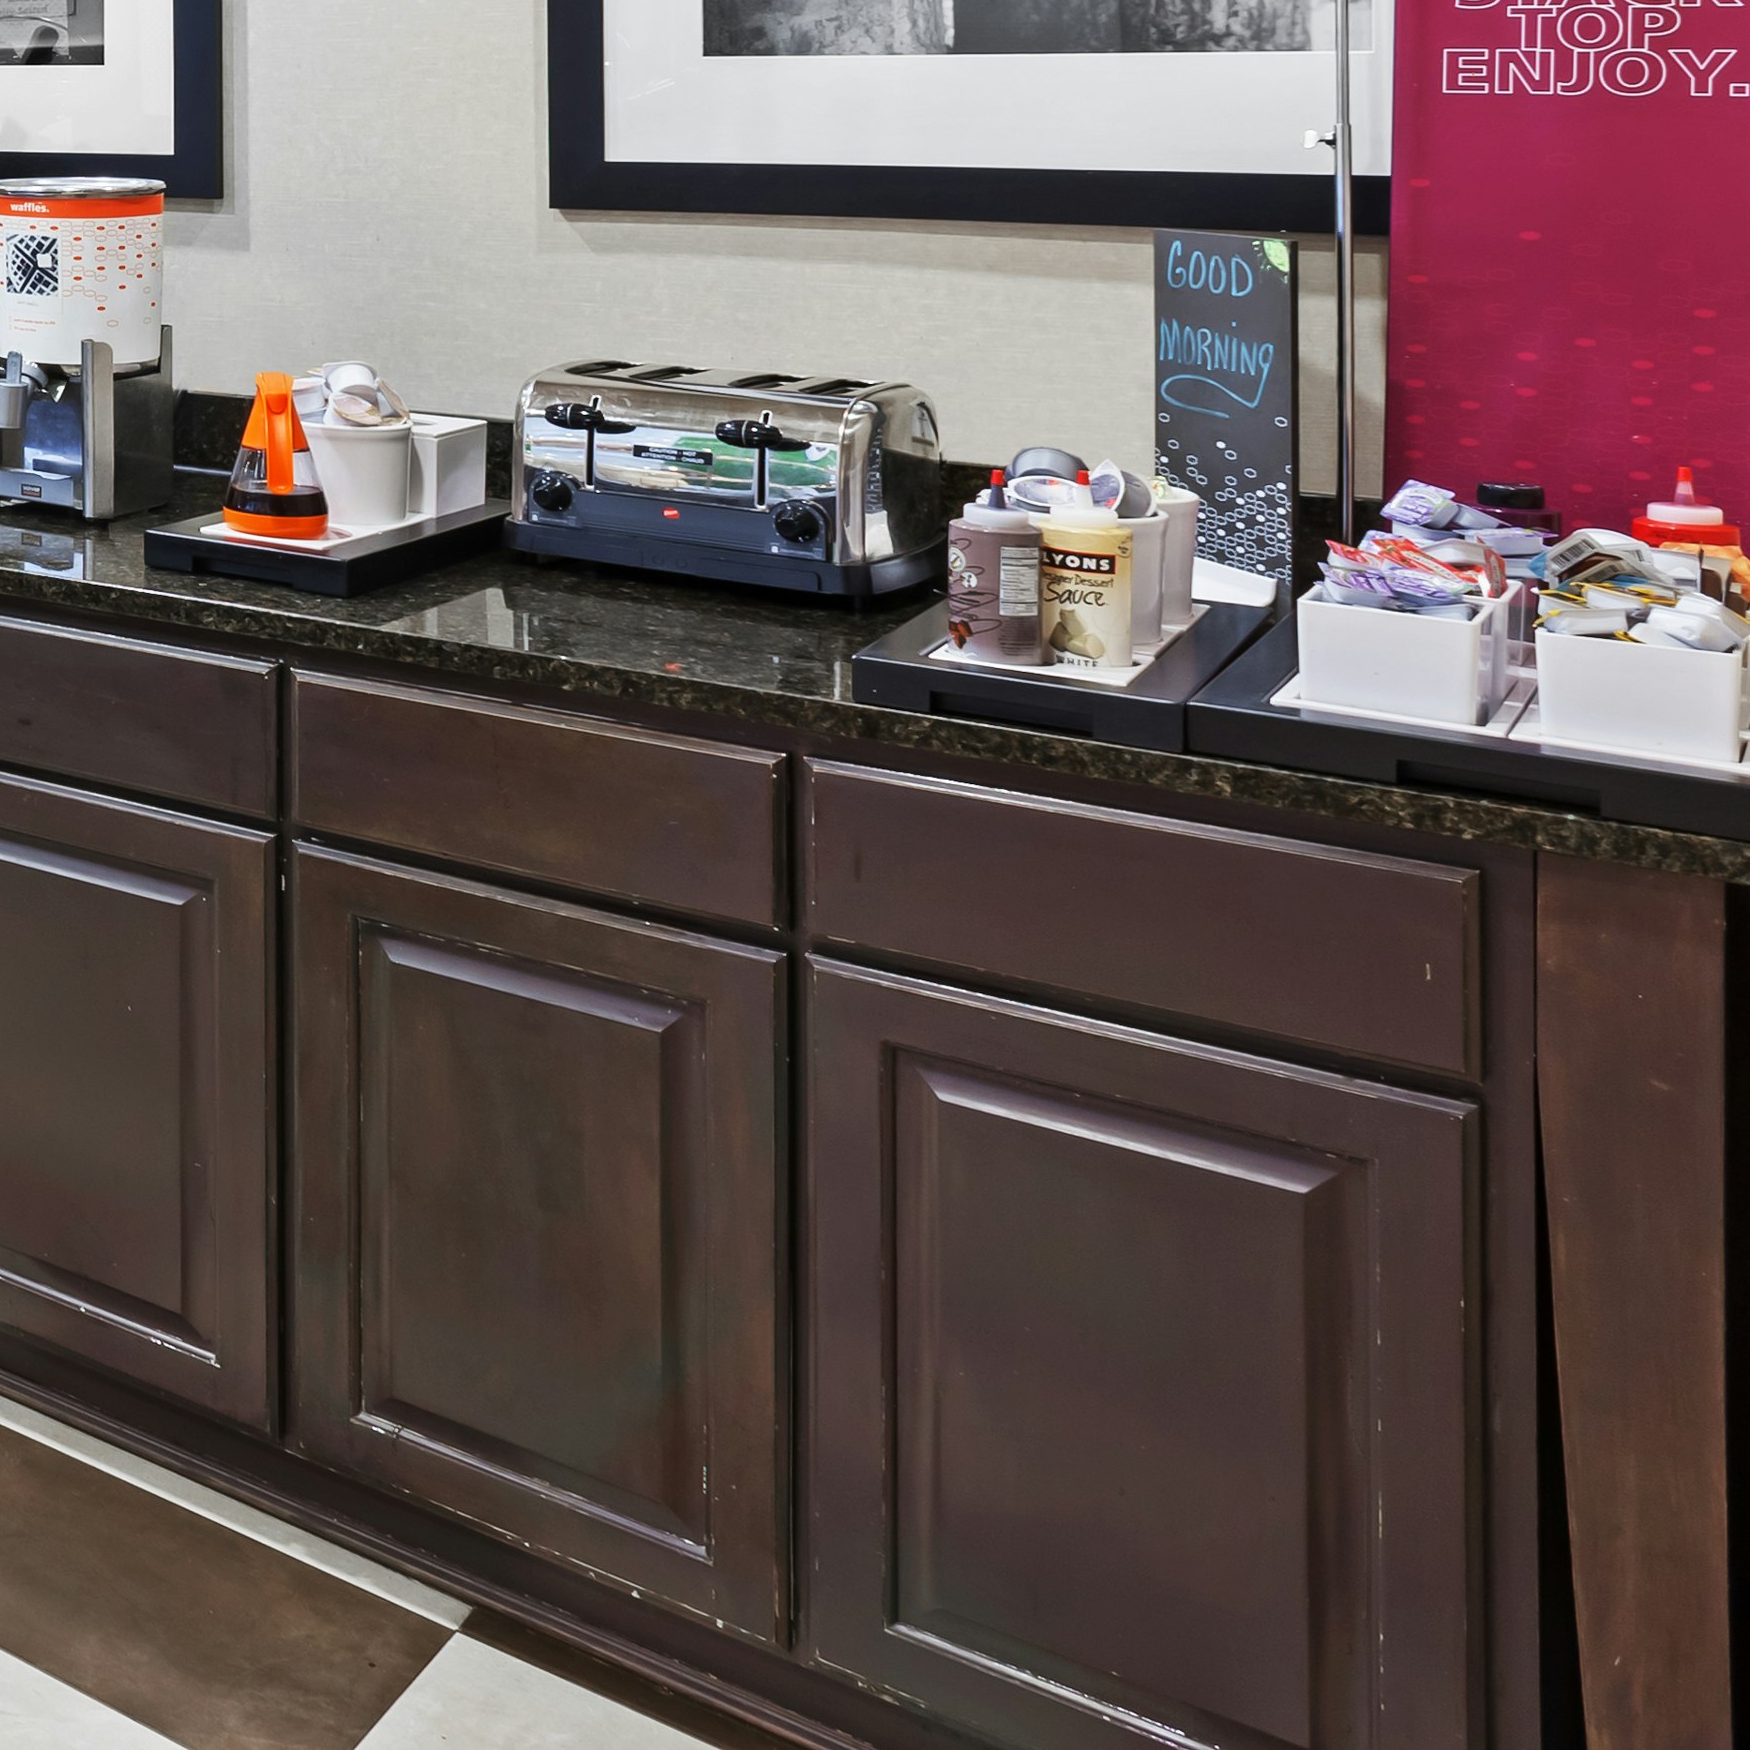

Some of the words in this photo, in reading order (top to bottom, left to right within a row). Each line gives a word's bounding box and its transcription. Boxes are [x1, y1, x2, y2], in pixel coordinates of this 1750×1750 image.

[1507, 6, 1681, 51] TOP
[1442, 48, 1750, 96] ENJOY.
[10, 202, 50, 213] waffles.
[1167, 239, 1253, 297] GOOD
[1042, 551, 1111, 571] LYONS
[1043, 580, 1106, 607] Sauce
[1074, 573, 1114, 588] Dessert
